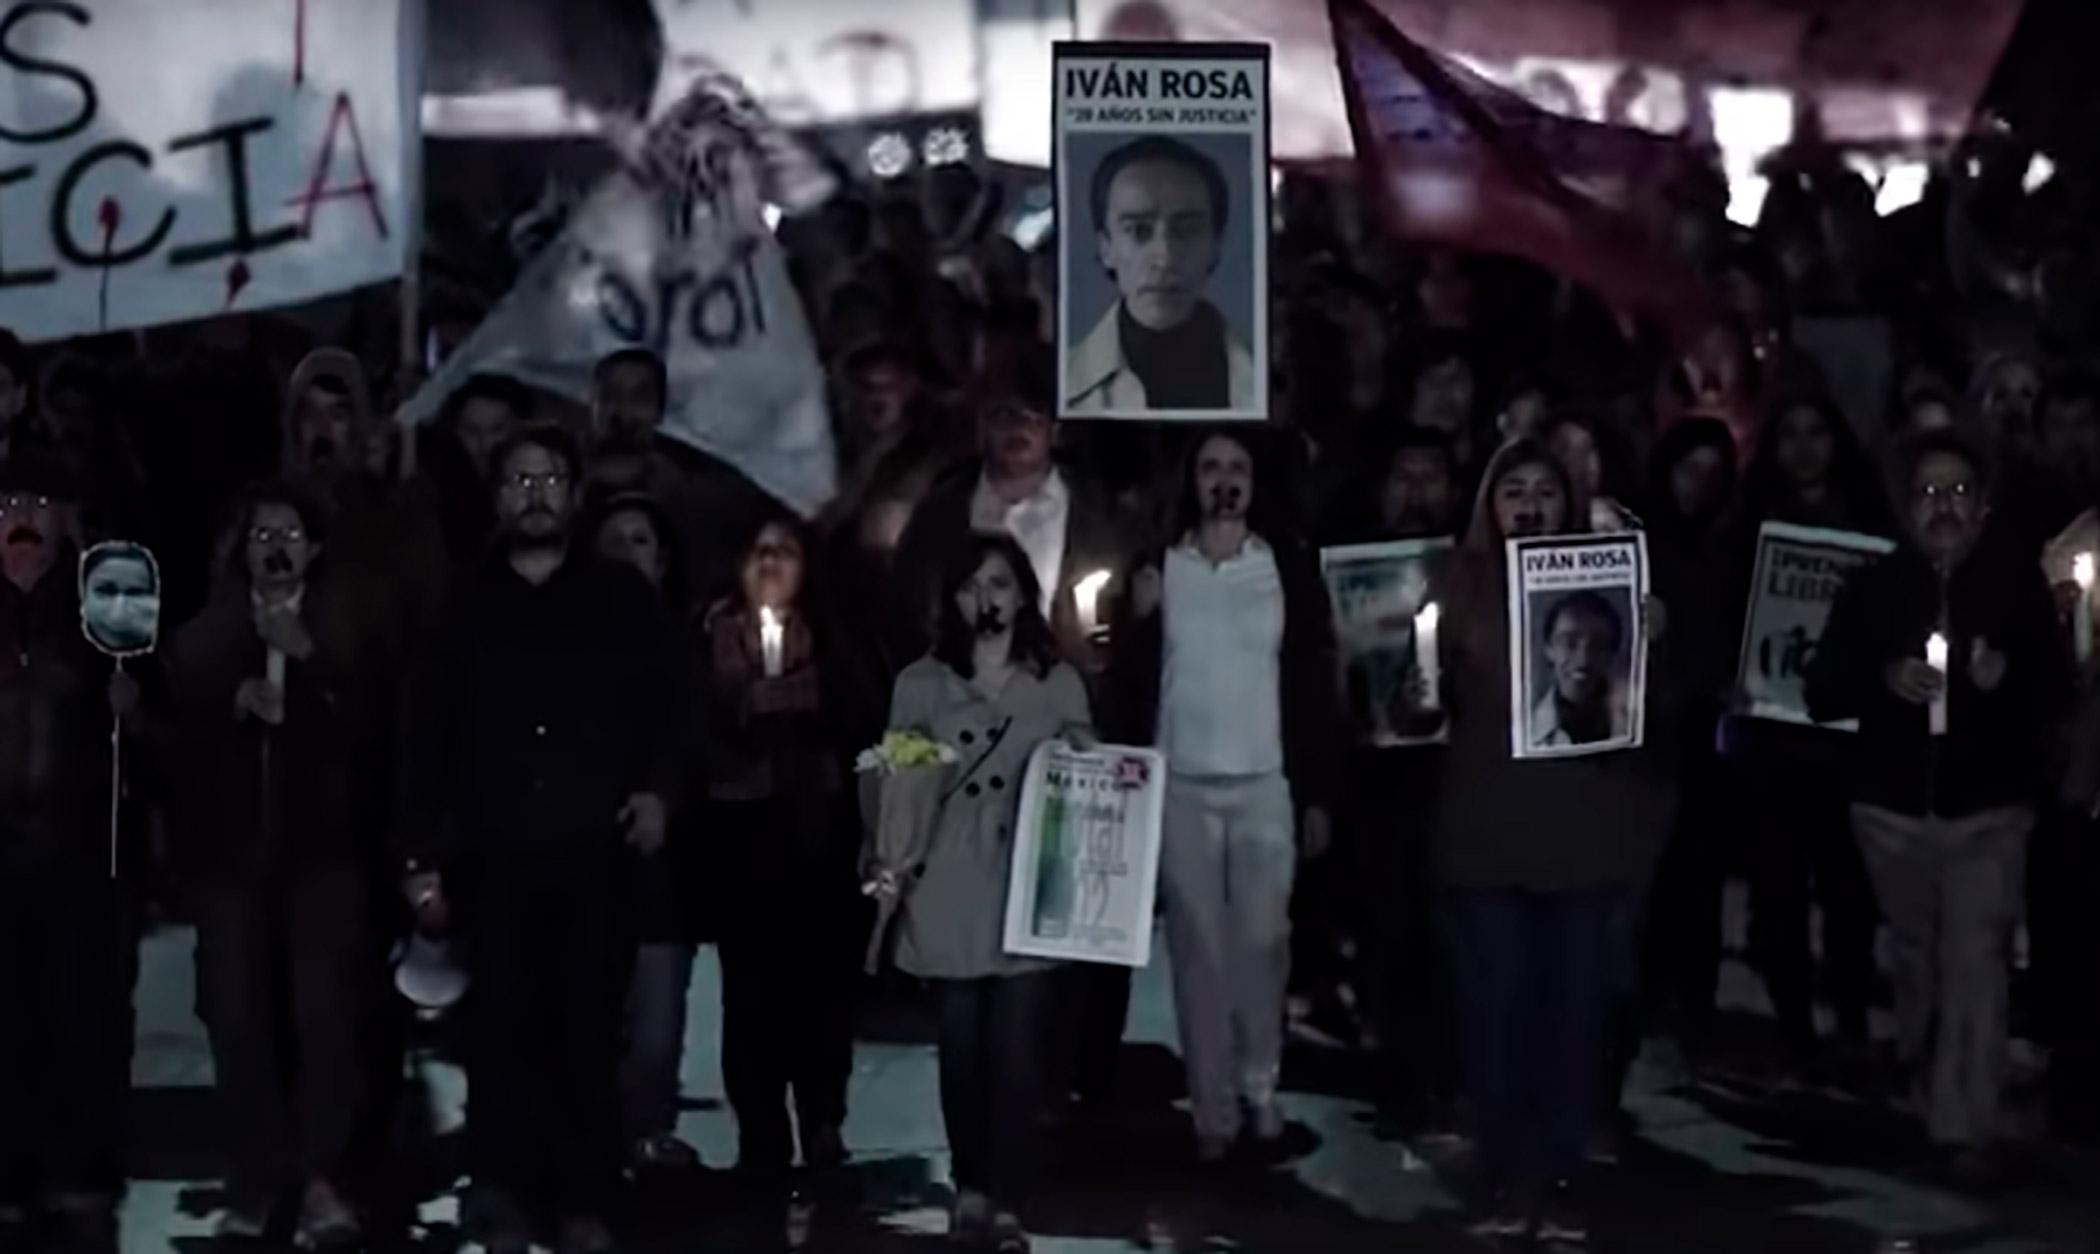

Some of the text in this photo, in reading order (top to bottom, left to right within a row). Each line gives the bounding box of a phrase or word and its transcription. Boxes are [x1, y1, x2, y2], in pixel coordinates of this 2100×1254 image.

[1066, 62, 1253, 99] IVÁN ROSA
[1097, 106, 1143, 123] AÑOS
[1147, 108, 1175, 123] SIN
[1579, 548, 1631, 570] ROSA
